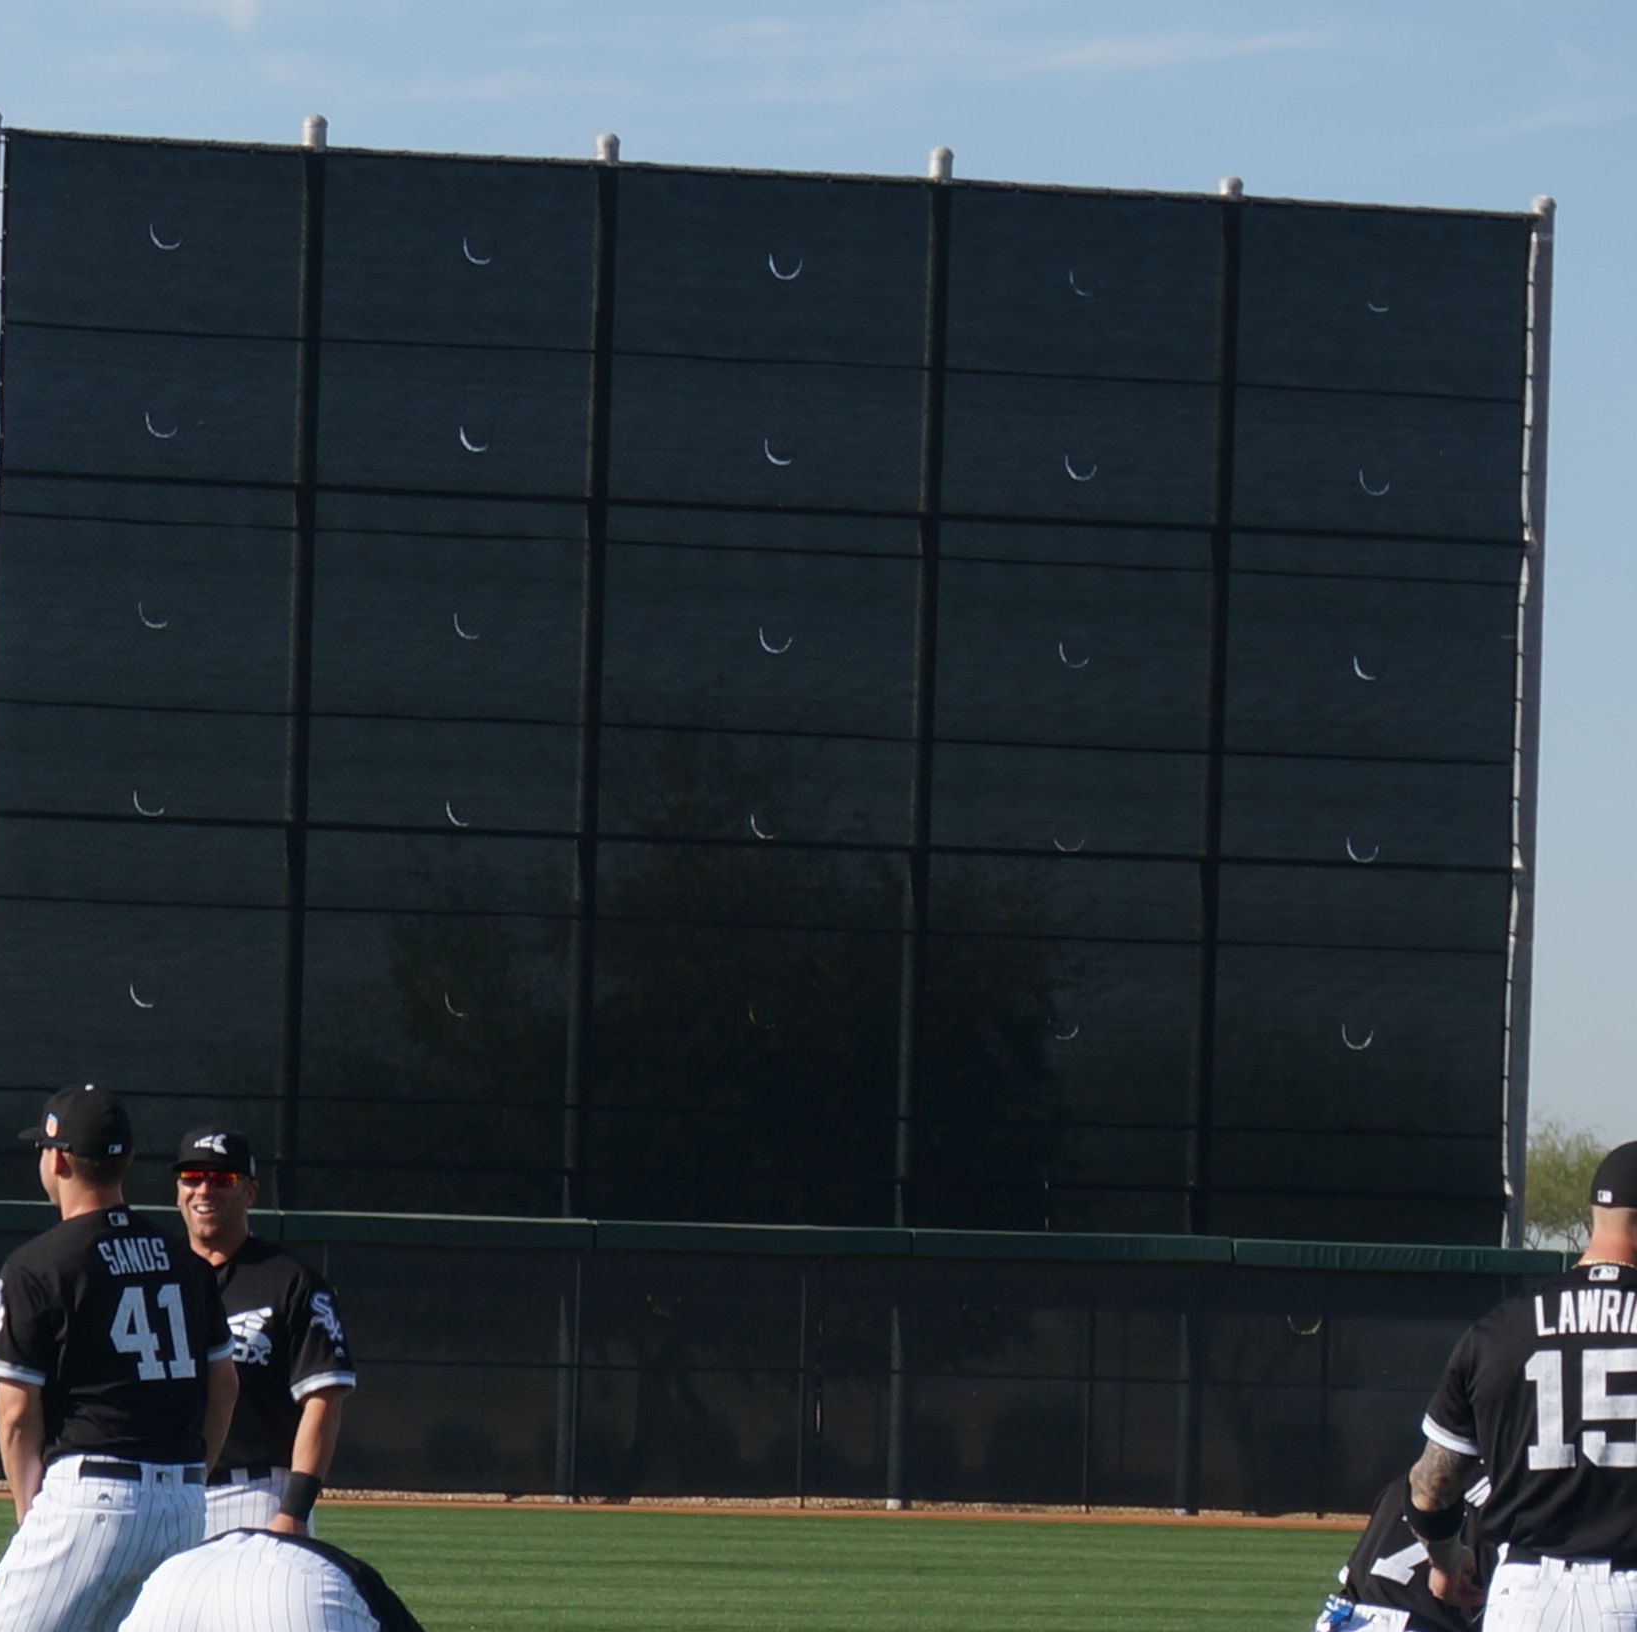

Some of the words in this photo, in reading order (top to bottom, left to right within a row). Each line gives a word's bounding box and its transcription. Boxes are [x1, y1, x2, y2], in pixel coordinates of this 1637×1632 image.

[98, 1236, 170, 1276] SANDS
[109, 1283, 197, 1381] 41
[1525, 1348, 1637, 1471] 15
